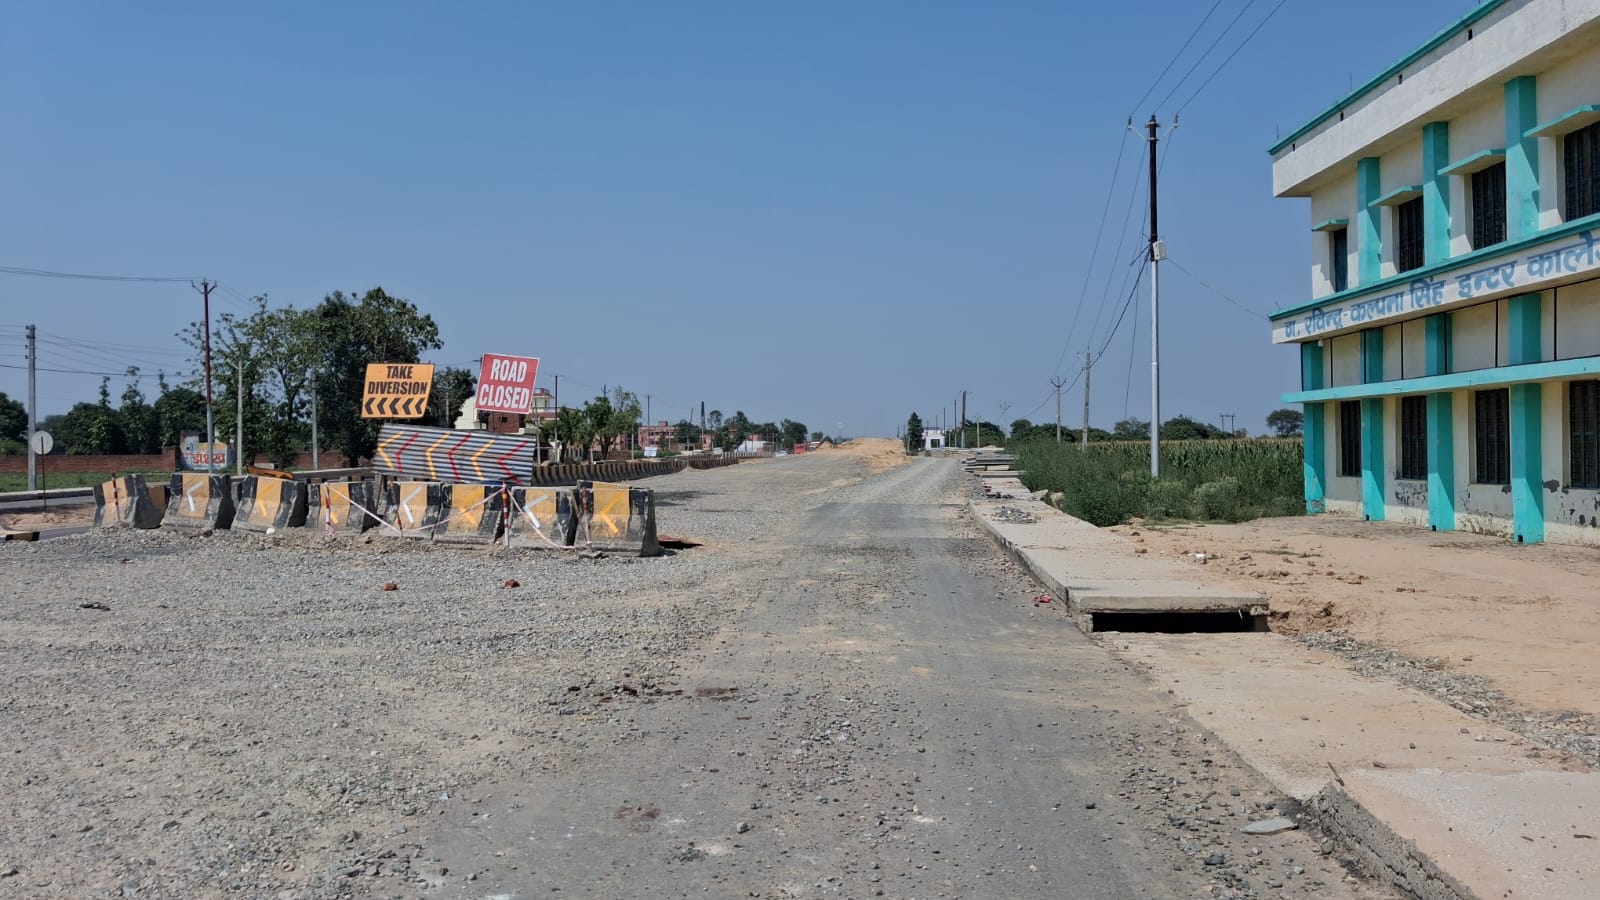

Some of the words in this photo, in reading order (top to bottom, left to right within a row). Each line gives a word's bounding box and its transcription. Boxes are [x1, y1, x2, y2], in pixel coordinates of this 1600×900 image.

[1409, 276, 1447, 309] सिंह
[1455, 260, 1518, 297] इन्टर
[386, 365, 413, 379] TAKE
[490, 358, 527, 383] ROAD
[368, 381, 428, 396] DIVERSION
[478, 383, 530, 409] CLOSED
